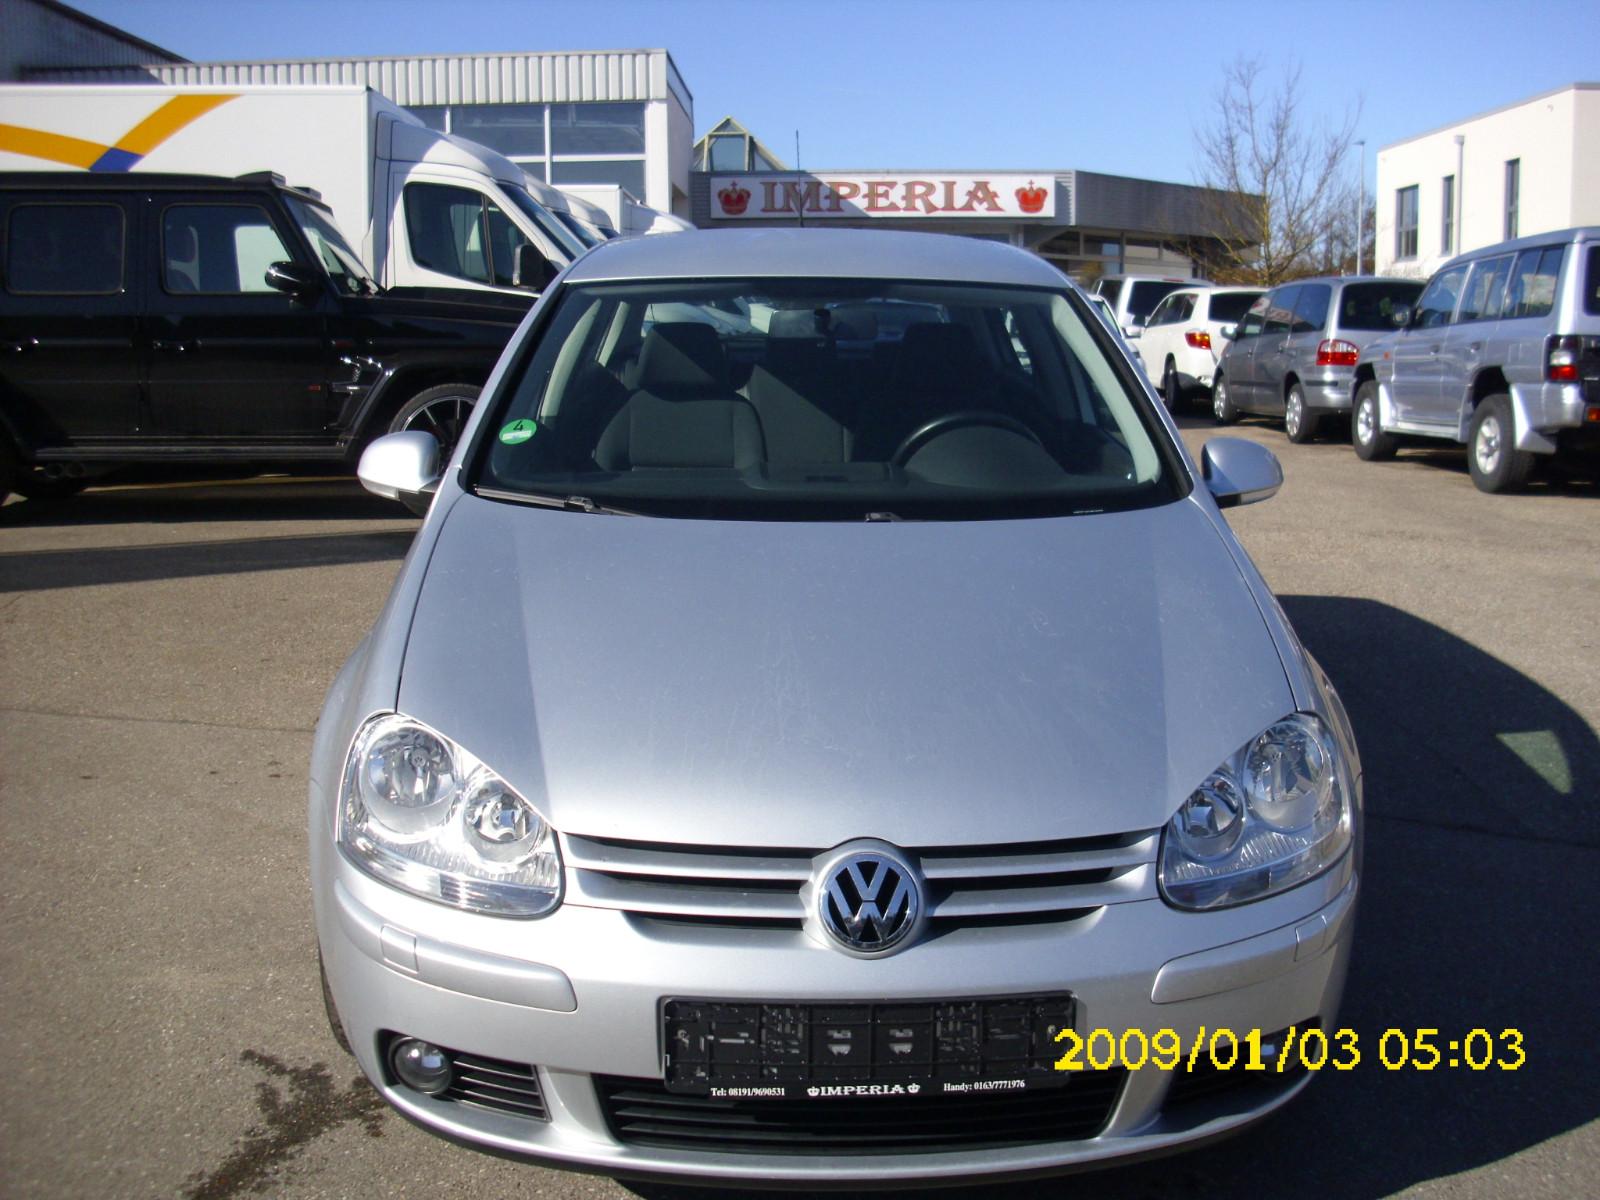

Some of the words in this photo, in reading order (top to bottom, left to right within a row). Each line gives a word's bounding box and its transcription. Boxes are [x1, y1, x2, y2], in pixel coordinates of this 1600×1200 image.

[759, 180, 1006, 215] IMPERIA
[513, 420, 524, 431] 4
[824, 855, 914, 948] VW
[710, 1087, 727, 1097] Tel:
[728, 1087, 785, 1097] 08191/9690531
[820, 1084, 905, 1096] IMPERIA
[943, 1082, 972, 1093] Handy:
[974, 1080, 1026, 1090] 0163/7771976
